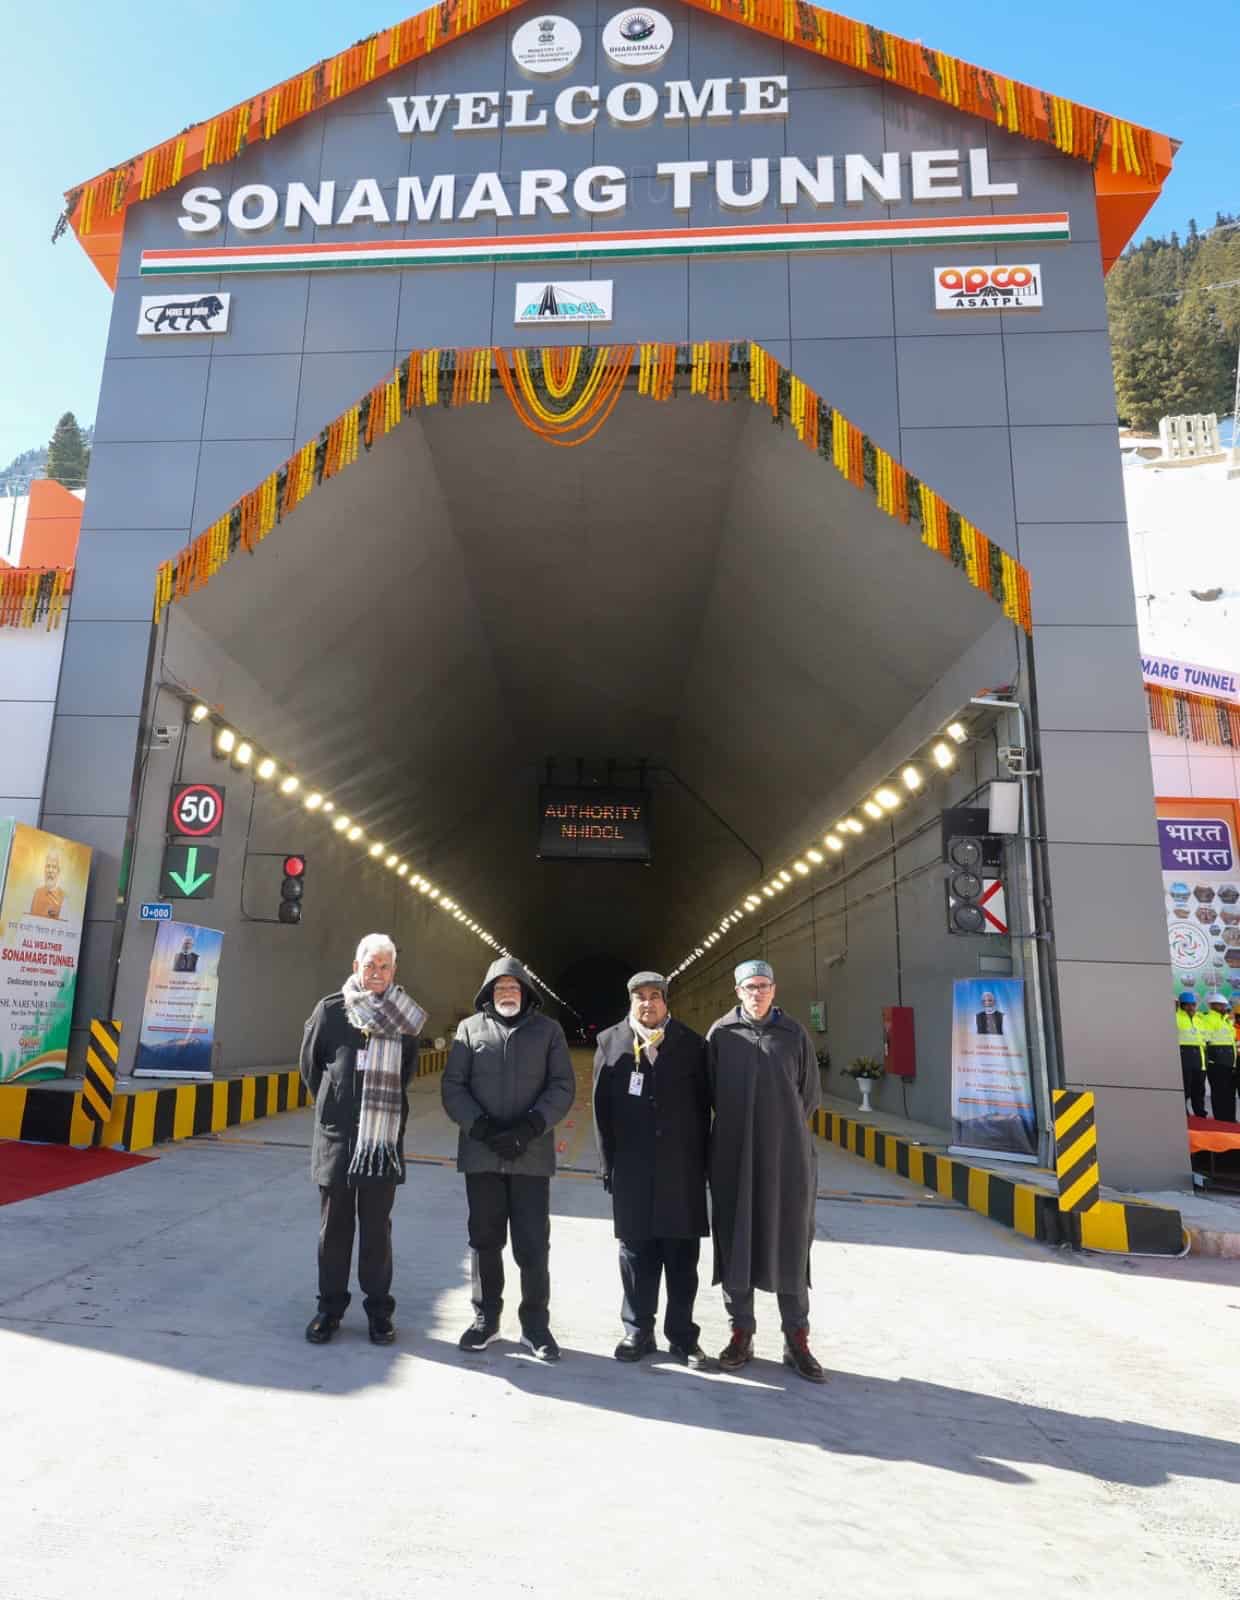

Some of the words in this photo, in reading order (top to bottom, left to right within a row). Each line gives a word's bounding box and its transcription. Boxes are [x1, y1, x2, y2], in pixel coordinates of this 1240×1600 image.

[387, 75, 790, 135] WELCOME
[177, 164, 628, 234] SONAMARG
[657, 147, 1020, 212] TUNNEL
[956, 297, 1023, 307] ASATPL
[1184, 668, 1236, 692] TUNNEL
[180, 796, 215, 823] 50
[544, 804, 640, 820] AUTHORITY
[561, 824, 625, 840] NHIDCL
[1165, 825, 1223, 842] भारत
[1172, 849, 1230, 866] भारत
[142, 906, 169, 918] 0+000
[22, 938, 33, 948] ALL
[34, 940, 63, 952] WEATHER
[1, 948, 47, 965] SONAMARG
[48, 954, 75, 968] TUNNEL
